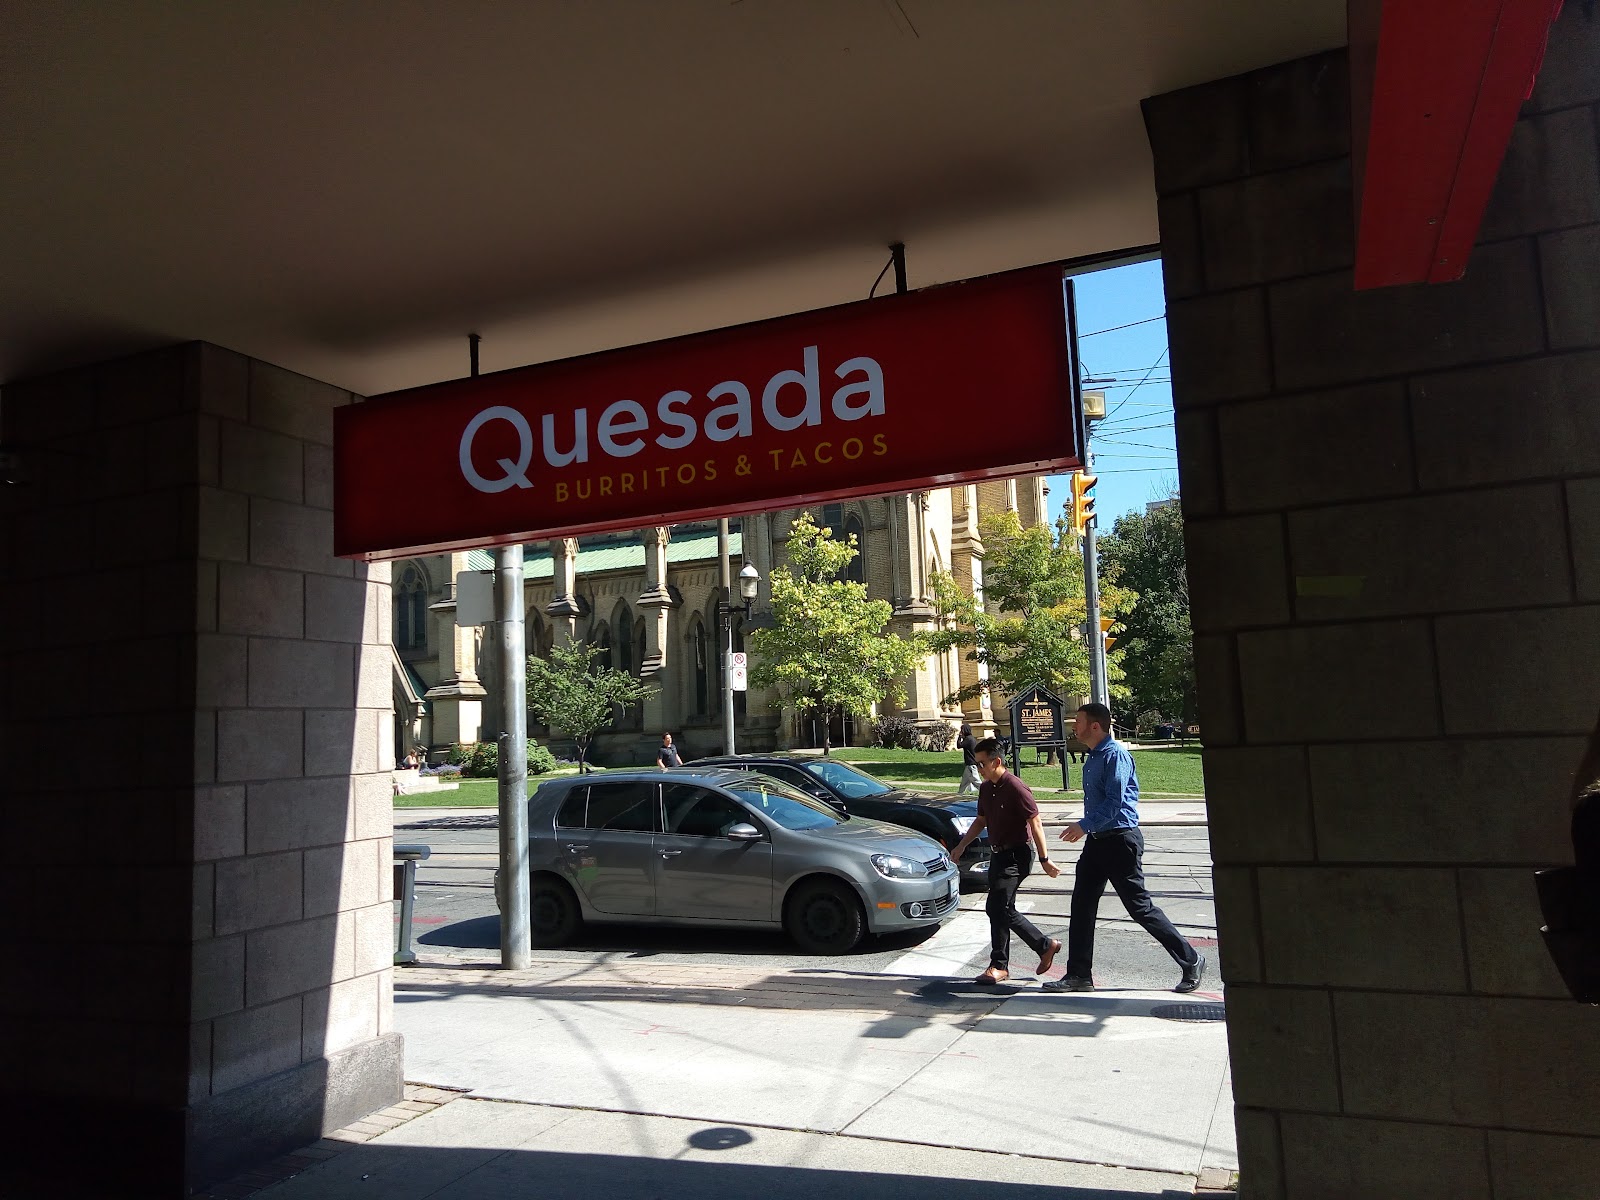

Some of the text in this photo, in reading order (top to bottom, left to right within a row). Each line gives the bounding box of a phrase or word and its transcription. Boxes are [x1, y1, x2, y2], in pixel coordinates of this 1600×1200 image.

[458, 345, 886, 494] Quesada
[556, 433, 888, 503] BURRITOS & TACOS
[1021, 708, 1053, 717] ST. JAMES
